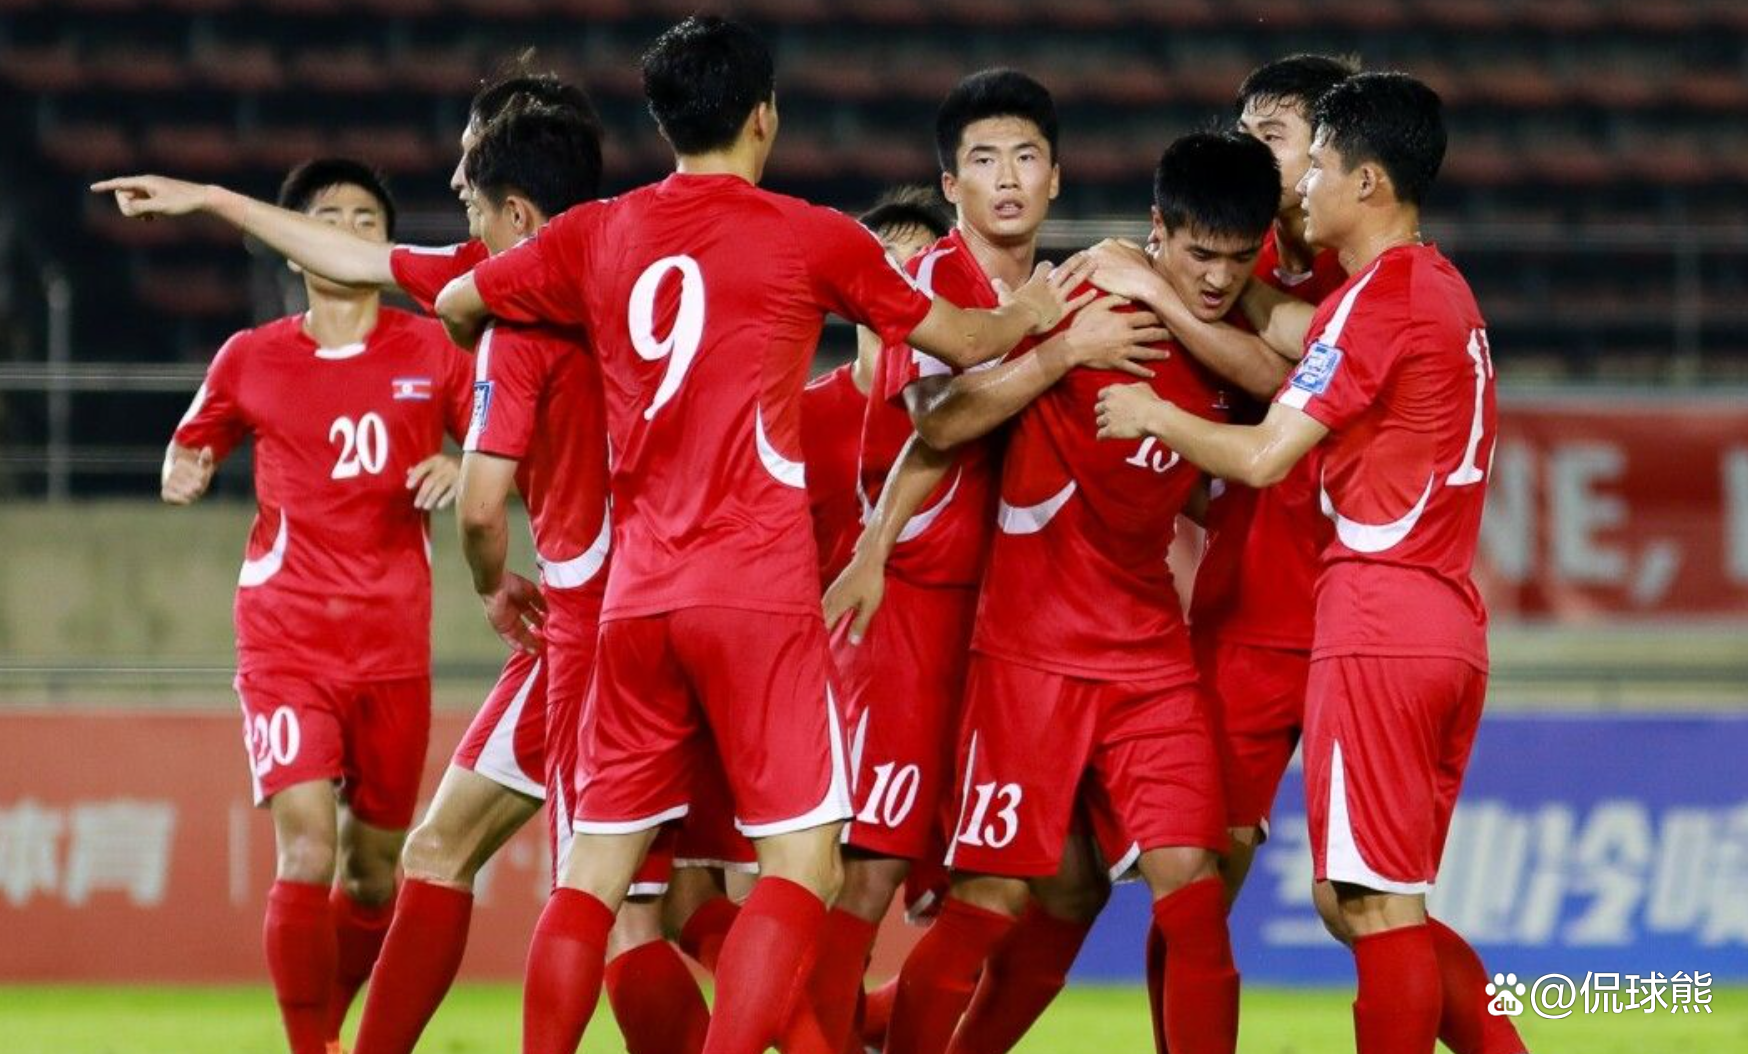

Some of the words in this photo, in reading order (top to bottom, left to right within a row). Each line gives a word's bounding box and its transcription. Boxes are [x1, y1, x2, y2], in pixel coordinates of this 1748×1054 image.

[628, 254, 706, 421] 9
[329, 412, 389, 480] 20
[252, 705, 301, 778] 20
[856, 761, 921, 829] 10
[958, 781, 1023, 849] 13
